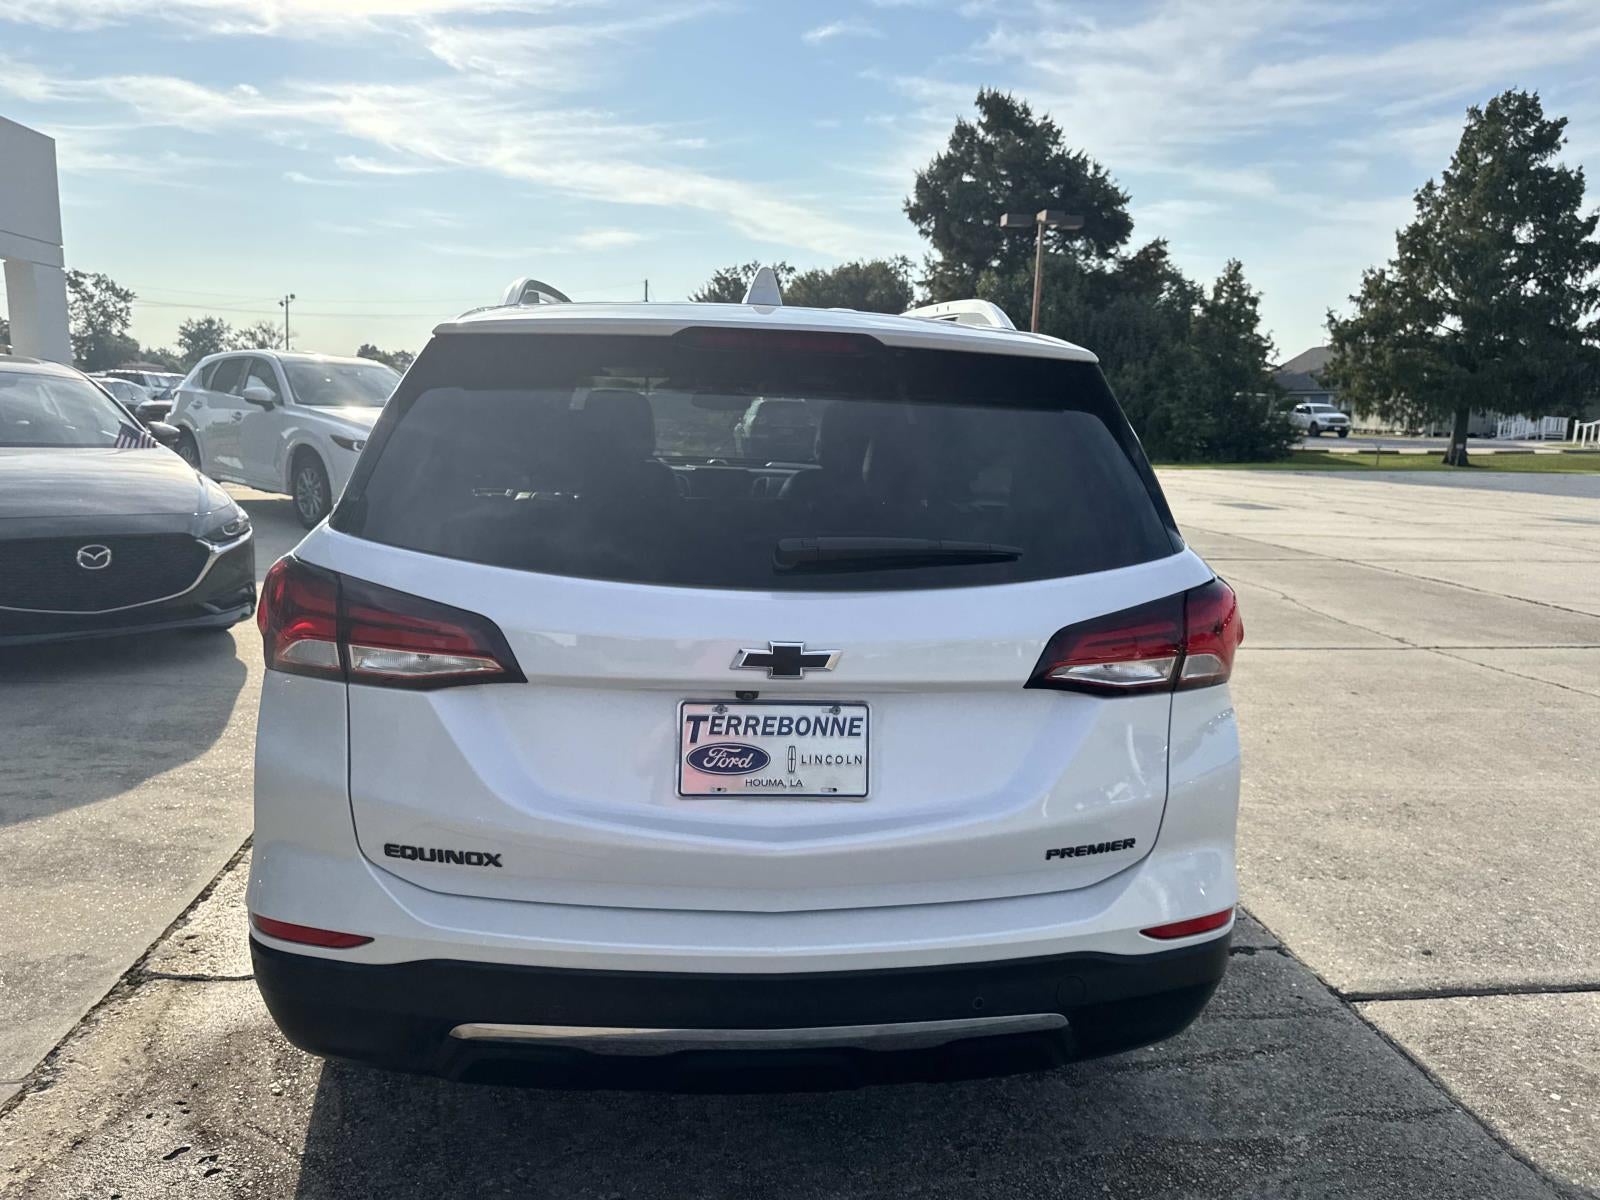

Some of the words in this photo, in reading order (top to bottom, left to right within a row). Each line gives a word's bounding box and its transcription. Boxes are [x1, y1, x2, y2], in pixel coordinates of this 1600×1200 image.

[686, 715, 864, 744] TERREBONNE
[703, 747, 754, 769] Ford
[801, 754, 863, 765] LINCOLN
[745, 778, 787, 788] HOUMA,
[790, 778, 803, 787] LA
[384, 843, 503, 868] EQUINOX
[1045, 837, 1136, 860] PREMIER
